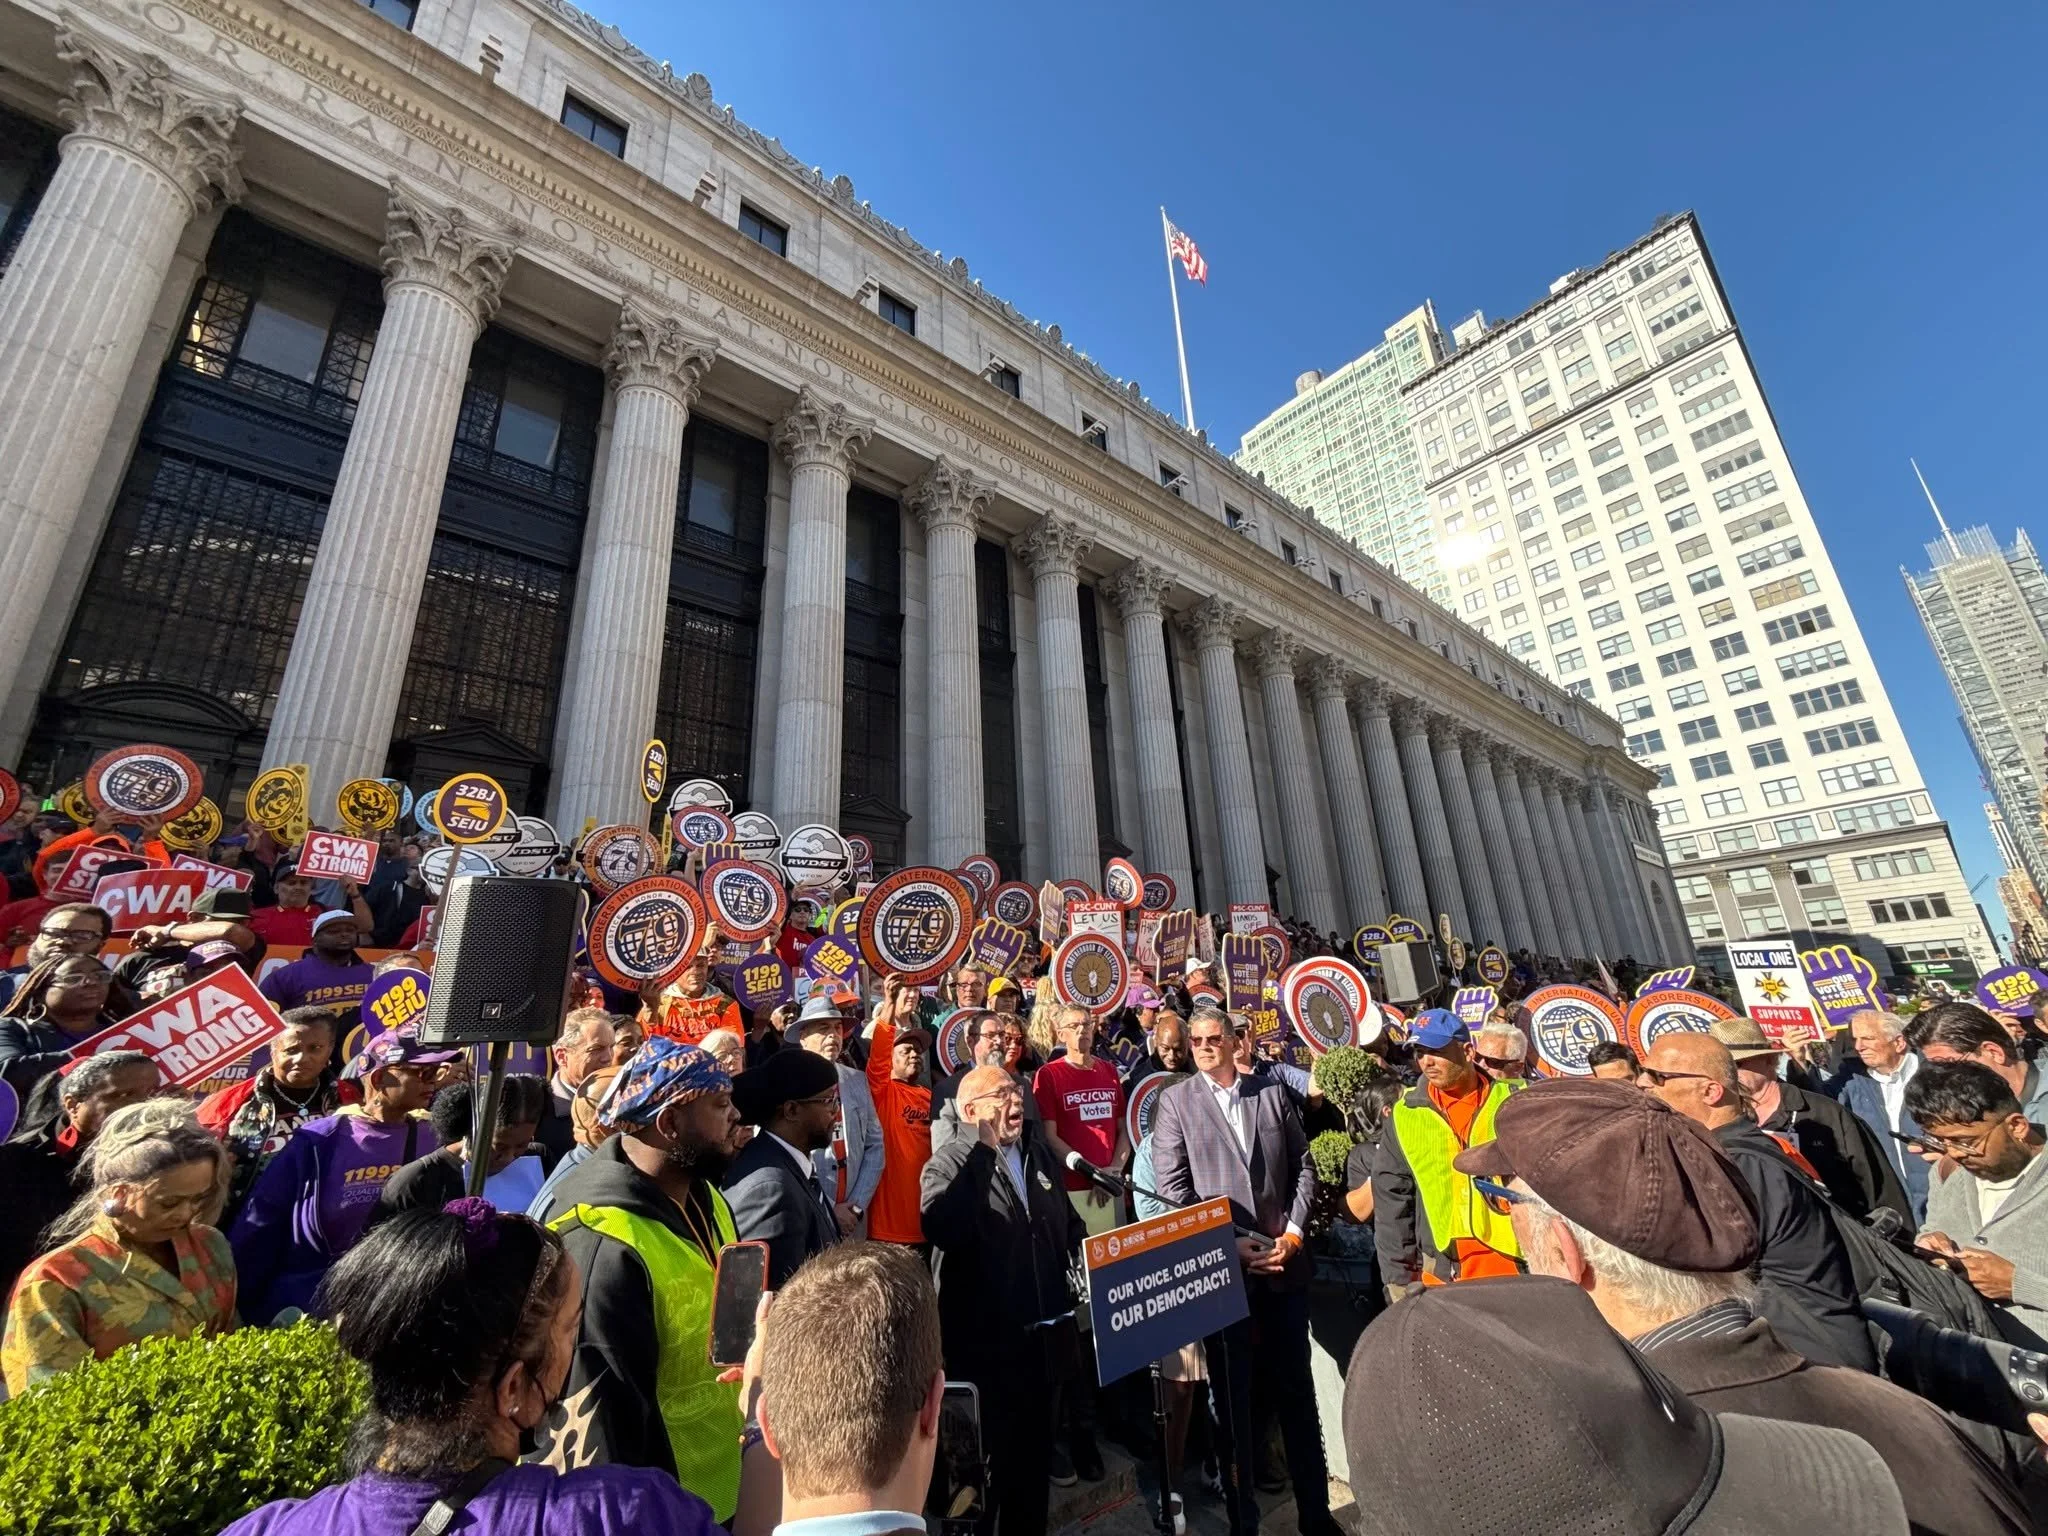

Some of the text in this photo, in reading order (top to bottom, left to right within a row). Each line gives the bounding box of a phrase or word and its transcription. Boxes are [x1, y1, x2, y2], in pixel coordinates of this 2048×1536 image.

[301, 82, 467, 188] RAIN
[508, 196, 622, 269] NOR
[649, 266, 764, 339] HEAT
[785, 343, 865, 394] NOR
[878, 391, 984, 456] GLOOM
[1000, 457, 1030, 480] OF
[1044, 479, 1117, 530] NIGHT
[1130, 525, 1189, 567] STAYS
[111, 764, 180, 806] 79
[456, 784, 496, 802] 32BJ
[645, 777, 661, 792] SEIU
[447, 816, 489, 831] SEIU
[311, 836, 370, 861] CWA
[511, 847, 553, 856] WDSU
[737, 840, 776, 849] WDSU
[307, 853, 369, 877] STRONG
[786, 857, 842, 867] RWDSU
[722, 860, 778, 892] INTERNATIONAL
[775, 890, 787, 914] UNION
[1109, 876, 1133, 895] 79
[99, 884, 192, 918] CWA
[720, 880, 773, 916] 79
[861, 869, 972, 940] LABORERS' INTERNATIONAL UNION
[1073, 902, 1119, 912] PSC-CUNY
[876, 884, 960, 932] JUSTICE HONOR STRENGTH
[590, 877, 706, 964] LABORERS' INTERNATIONAL UNION
[608, 914, 623, 950] JUSTICE
[635, 893, 664, 905] HONOR
[1072, 913, 1094, 925] LET
[1101, 913, 1120, 924] US
[1233, 914, 1258, 922] HANDS
[619, 911, 690, 964] 79
[888, 906, 952, 951] 79
[1362, 932, 1385, 940] 32BJ
[1393, 925, 1415, 934] 32BJ
[720, 957, 745, 966] POWE
[822, 940, 854, 967] 1199
[980, 950, 998, 961] VOTE
[993, 947, 1009, 958] OUR
[1733, 950, 1794, 967] LOCAL ONE
[743, 963, 781, 981] 1199
[813, 950, 848, 976] SEIU
[911, 960, 950, 983] America
[989, 960, 1003, 969] OUR
[1233, 970, 1250, 978] VOTE
[1832, 973, 1856, 984] OUR
[1985, 971, 2031, 995] 1199
[746, 975, 783, 994] SEIU
[1233, 985, 1259, 995] POWER
[1816, 983, 1844, 995] VOTE
[1840, 988, 1864, 998] OUR
[1994, 980, 2040, 1006] SEIU
[370, 976, 418, 1020] 1199
[1640, 992, 1706, 1011] LABORERS'
[1823, 996, 1869, 1010] POWER
[381, 990, 427, 1031] SEIU
[1531, 987, 1627, 1042] INTERNATIONAL UNION
[1656, 1004, 1695, 1014] JUSTICE
[1757, 1008, 1803, 1021] SUPPORTS
[1255, 1018, 1280, 1035] SEIU
[1538, 1017, 1606, 1060] 79
[1291, 1046, 1311, 1057] 119
[1066, 1090, 1117, 1106] PSC/CUNY
[1083, 1105, 1112, 1117] Votes
[1107, 1247, 1227, 1304] OUR VOICE. OUR VOTE.
[1110, 1267, 1231, 1332] OUR DEMOCRACY!
